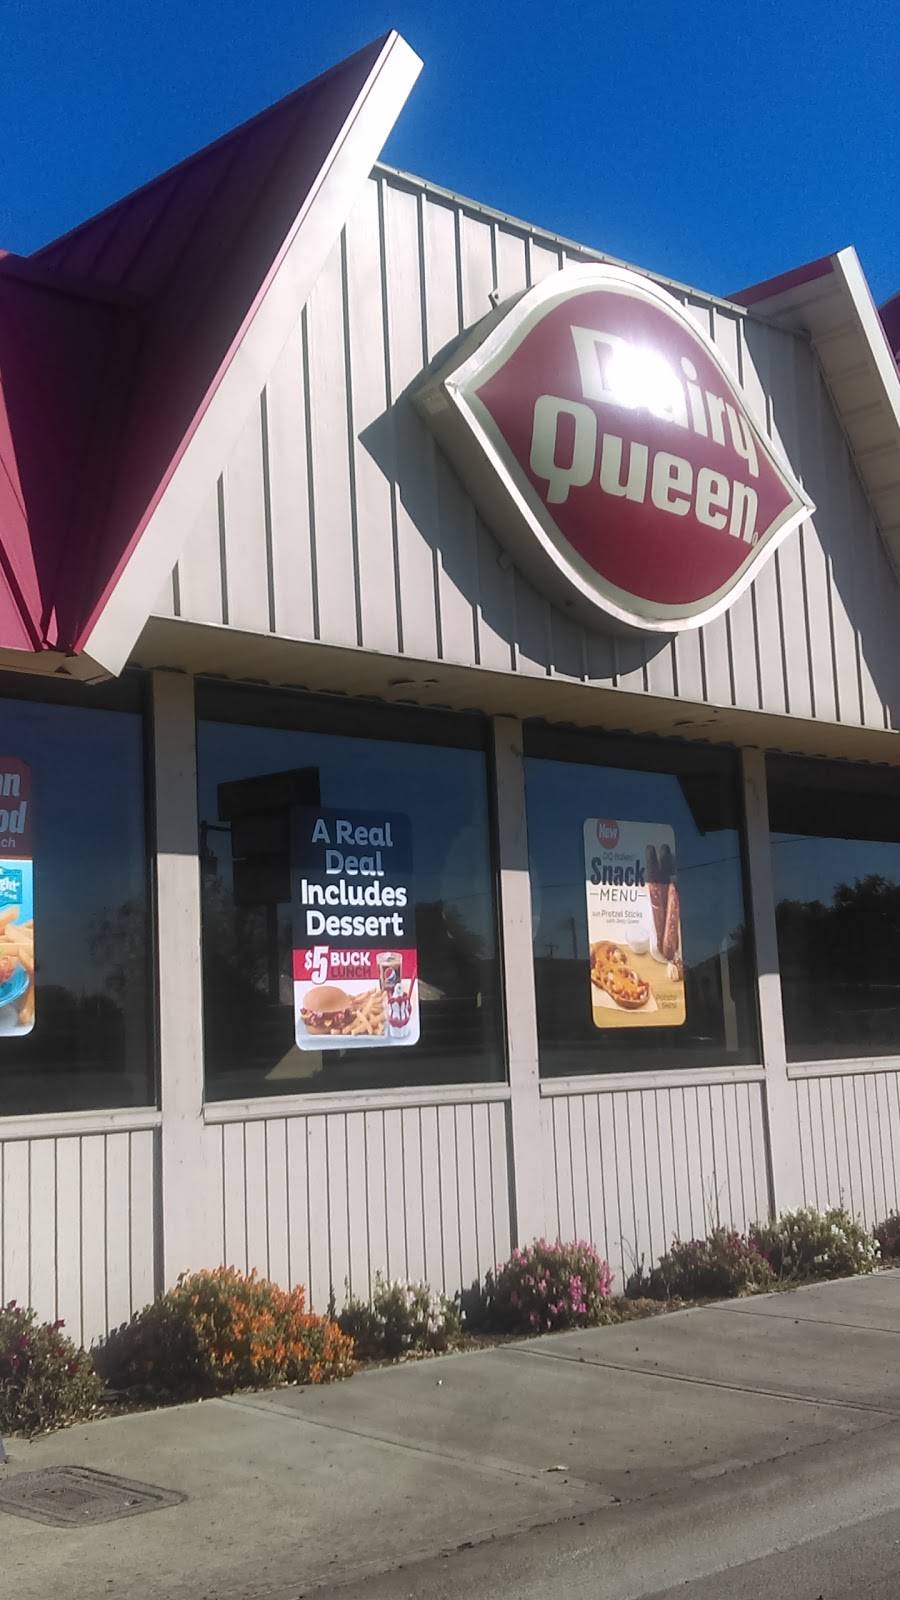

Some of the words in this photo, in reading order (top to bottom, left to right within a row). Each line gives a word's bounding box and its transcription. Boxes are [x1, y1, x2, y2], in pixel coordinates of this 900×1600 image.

[570, 325, 759, 477] Diry
[530, 394, 759, 545] Queen
[311, 819, 331, 844] A
[336, 820, 394, 847] Real
[325, 850, 385, 876] Deal
[590, 857, 646, 887] Snack
[301, 879, 408, 907] Includes
[600, 888, 638, 902] MENU
[306, 910, 404, 936] Dessert
[304, 945, 330, 985] $5
[330, 951, 371, 967] BUCK
[330, 966, 372, 978] LUNCH
